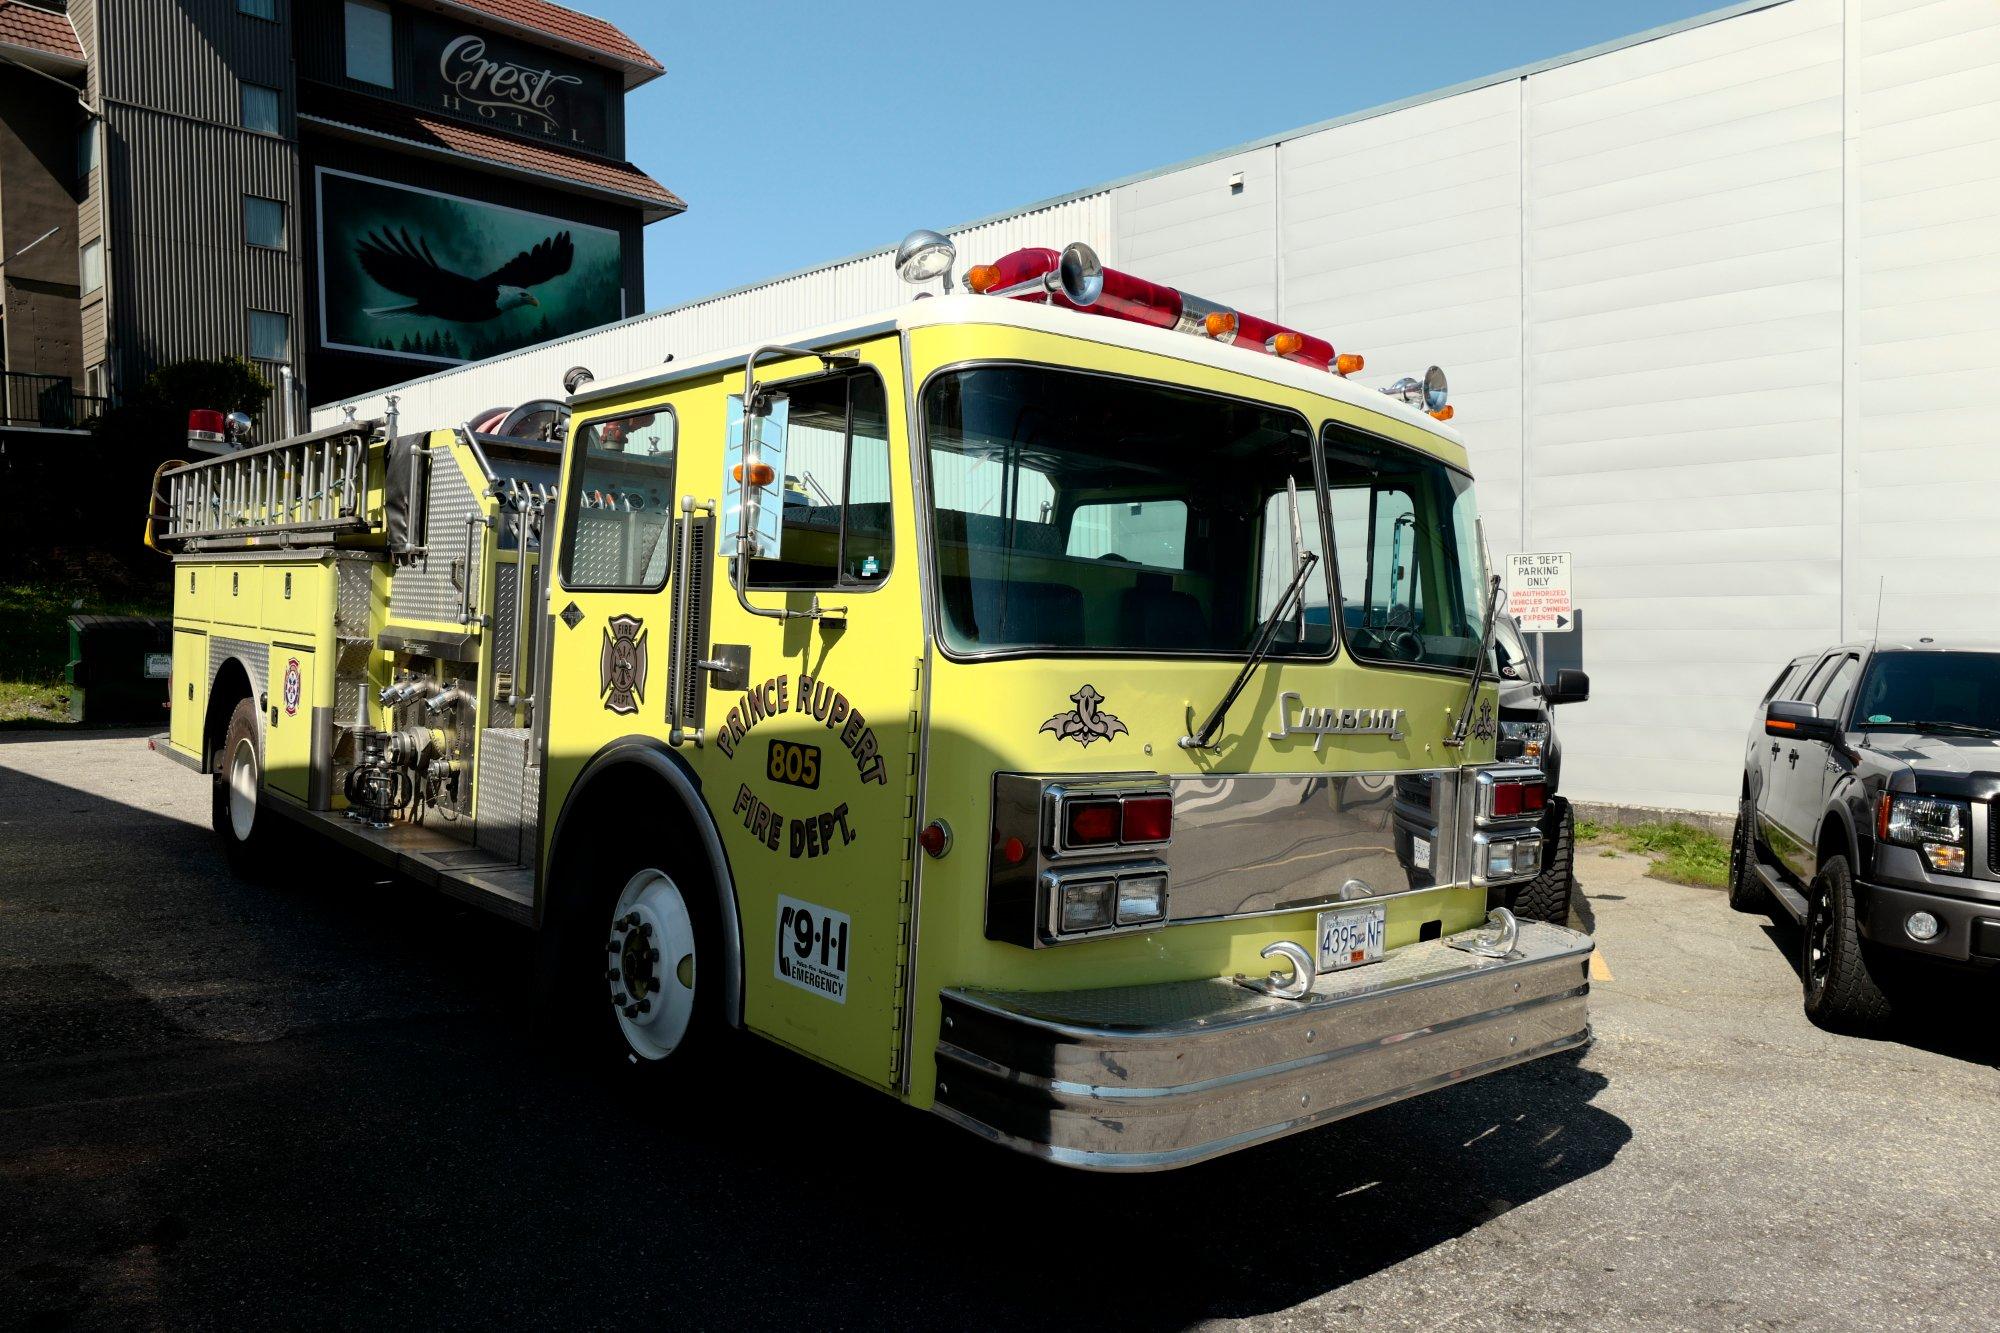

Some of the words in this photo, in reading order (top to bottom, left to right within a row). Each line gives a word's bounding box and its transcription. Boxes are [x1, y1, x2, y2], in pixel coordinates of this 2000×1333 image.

[440, 35, 583, 110] Crest
[442, 94, 585, 143] HOTEL
[1513, 556, 1534, 566] FIRE
[1518, 566, 1559, 576] PARKING
[1527, 577, 1550, 587] ONLY
[1509, 598, 1543, 606] VEHICLES
[1541, 605, 1571, 613] OWNERS
[617, 624, 632, 635] FIRE
[717, 674, 790, 760] PRINCE
[796, 674, 888, 786] RUPERT
[1267, 692, 1406, 752] Superior
[770, 742, 818, 785] 805
[733, 782, 784, 851] FIRE
[790, 802, 856, 859] DEPT.
[1322, 925, 1358, 956] 4395
[1367, 920, 1384, 947] NF
[791, 966, 844, 997] EMERGENCY
